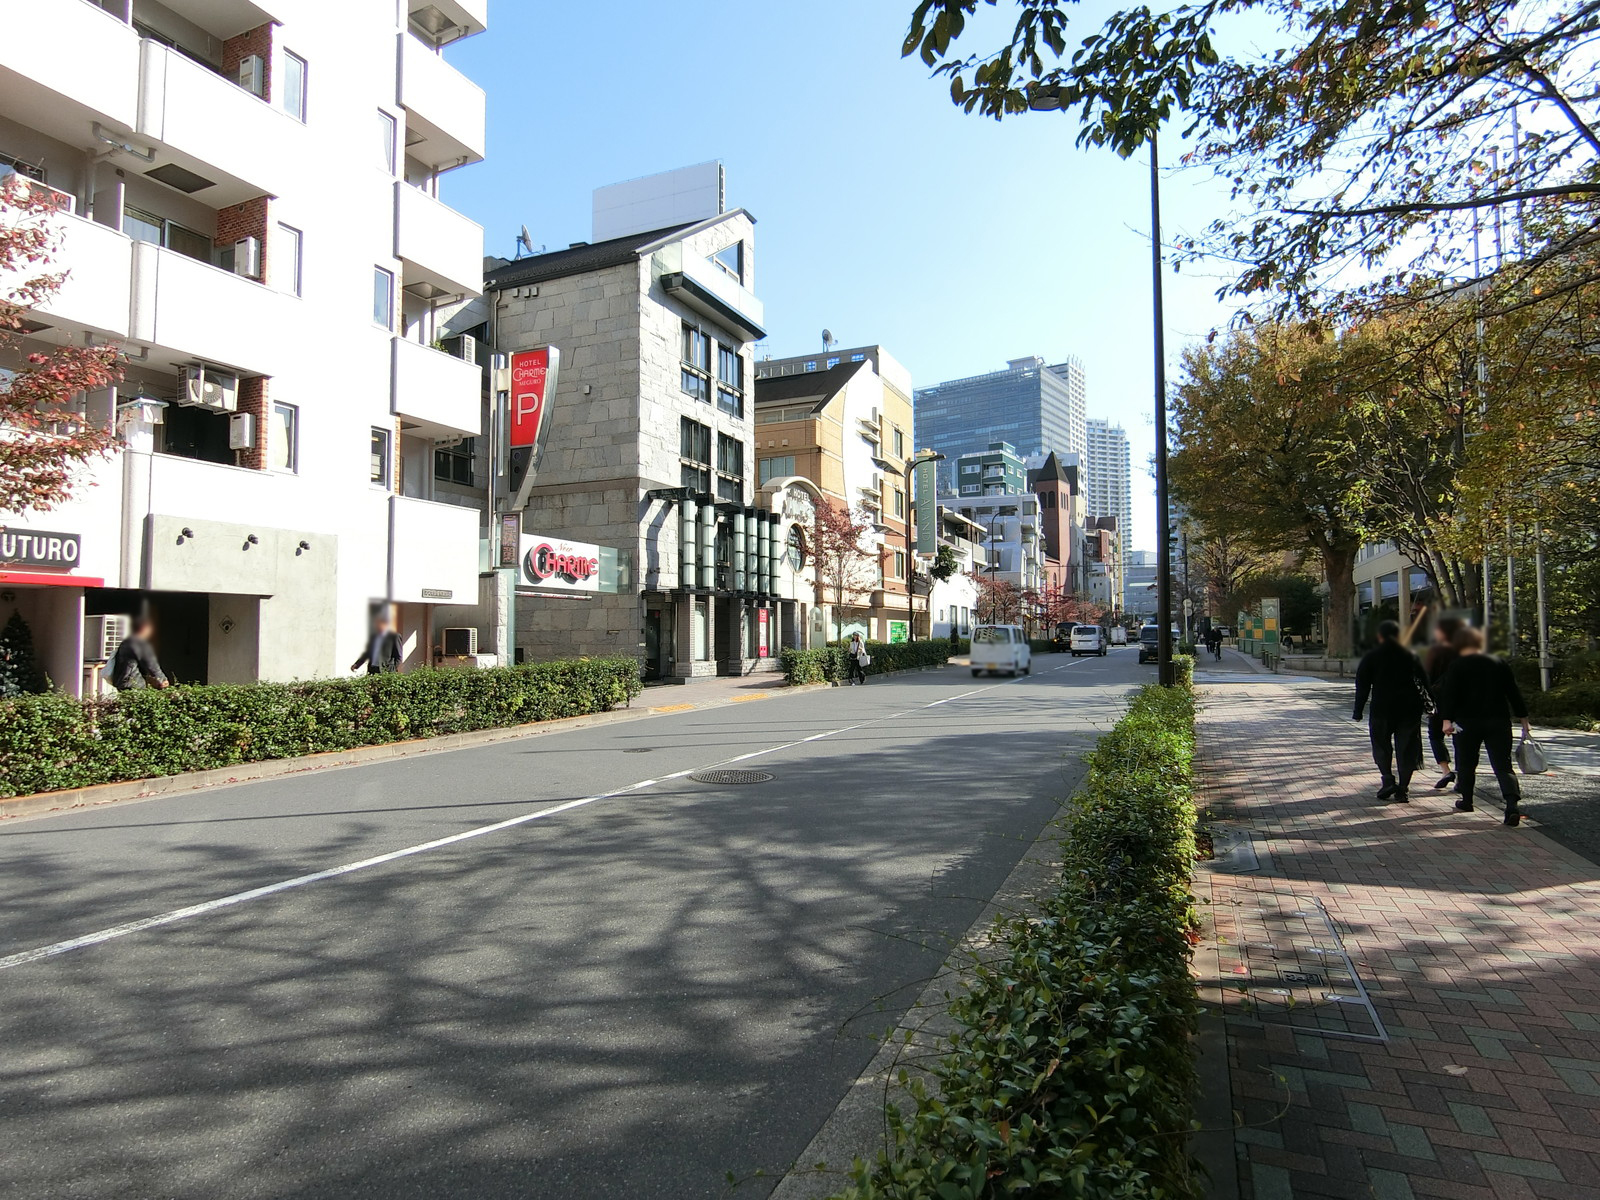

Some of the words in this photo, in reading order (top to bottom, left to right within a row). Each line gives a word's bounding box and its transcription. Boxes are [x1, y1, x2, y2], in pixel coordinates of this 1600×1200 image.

[512, 367, 546, 382] CHARME
[519, 360, 542, 368] HOTEL
[517, 392, 539, 425] P
[922, 468, 930, 495] HOTEL
[531, 543, 598, 578] CHARME
